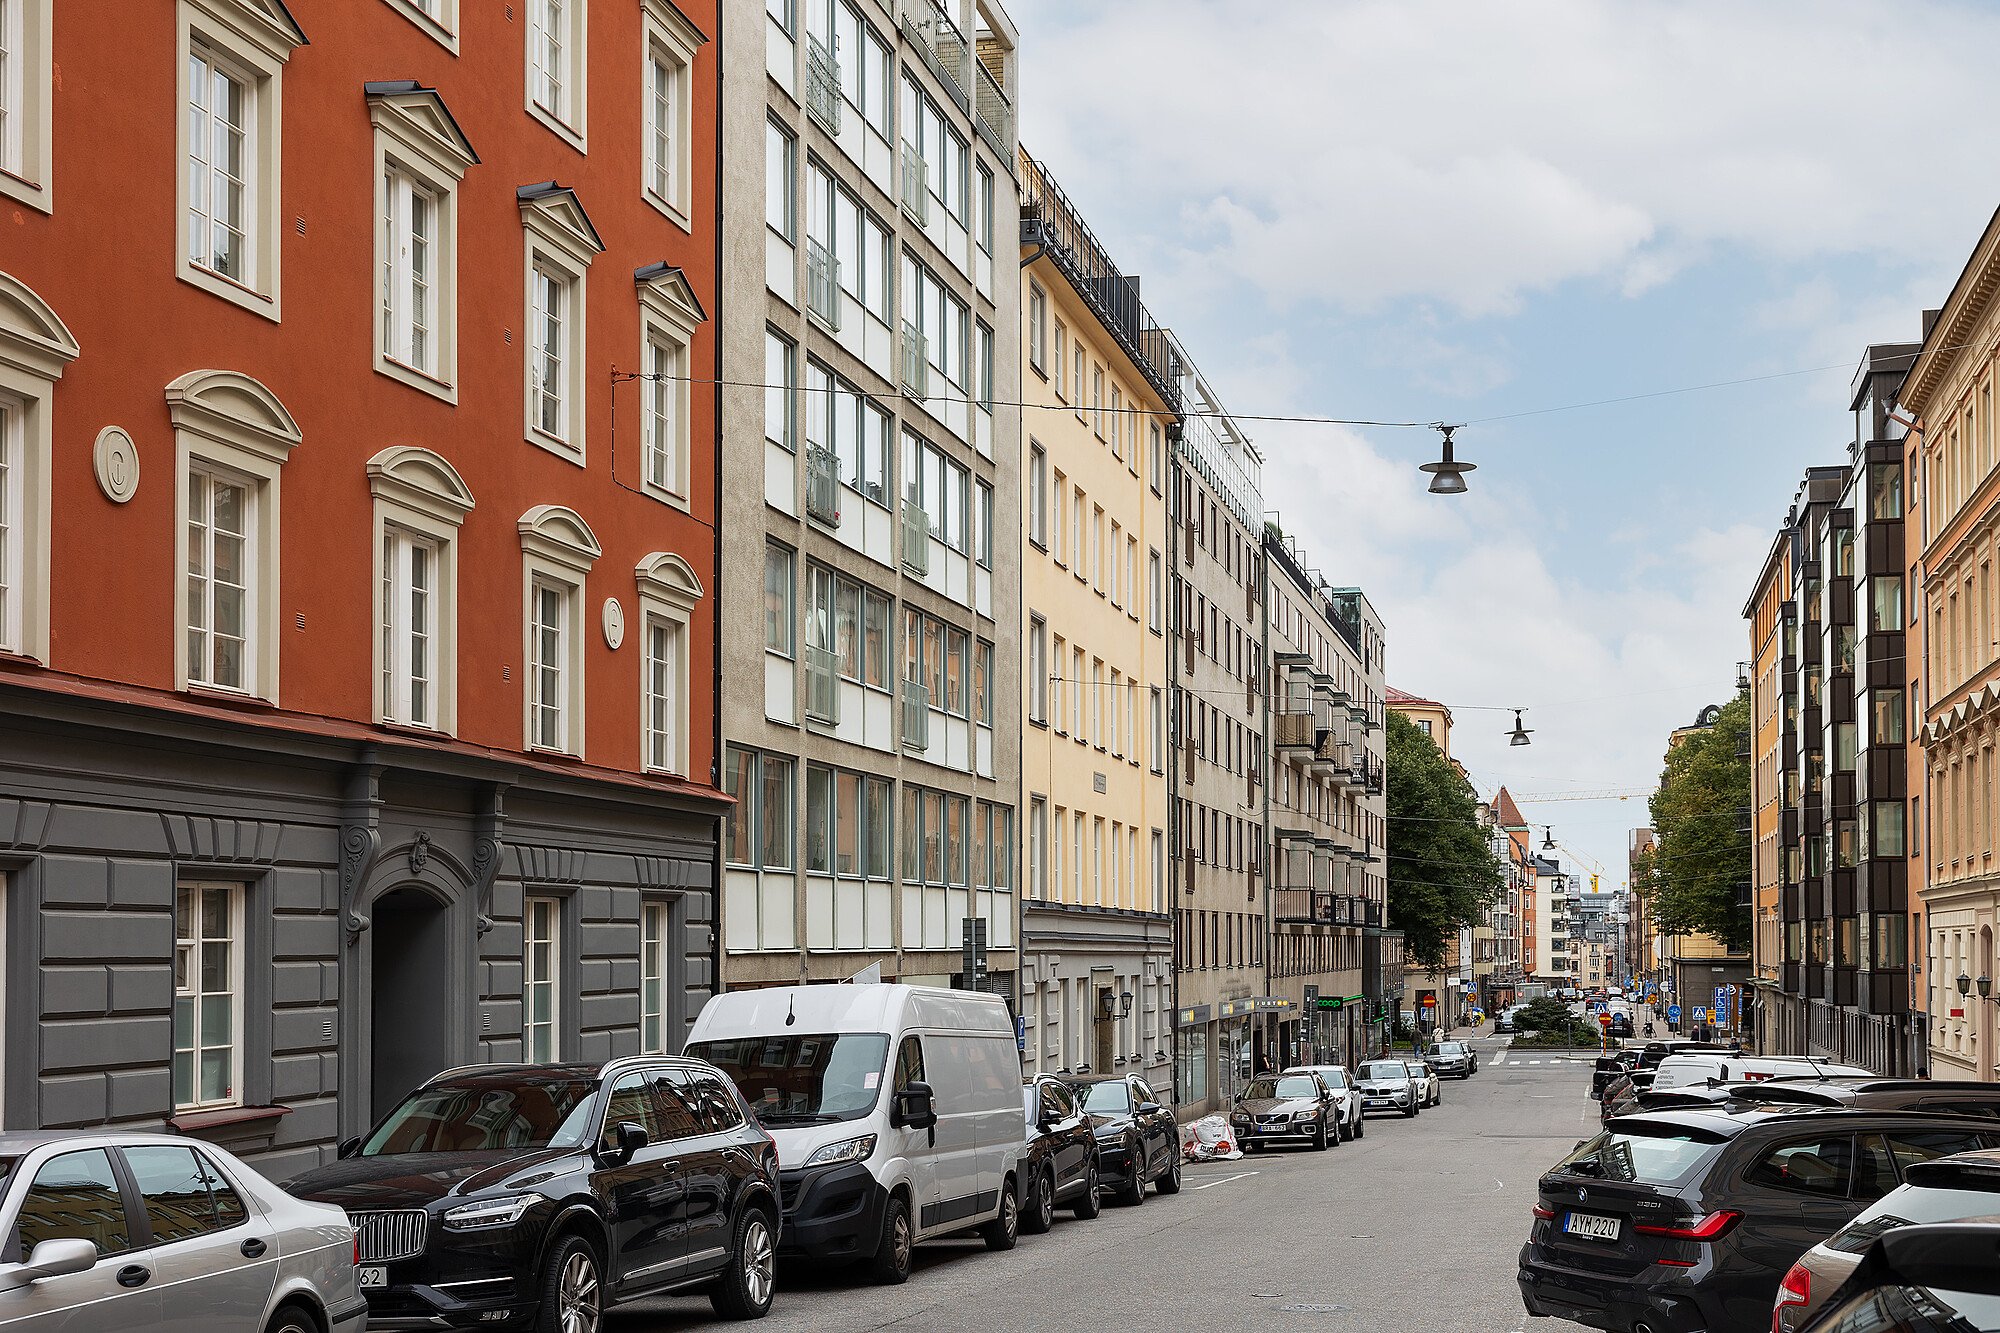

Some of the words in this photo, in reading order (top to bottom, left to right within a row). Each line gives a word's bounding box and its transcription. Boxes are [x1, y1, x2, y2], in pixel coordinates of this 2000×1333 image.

[1717, 988, 1724, 997] P
[1318, 1000, 1341, 1008] coop
[1593, 1218, 1615, 1236] 220
[360, 1269, 381, 1285] 62
